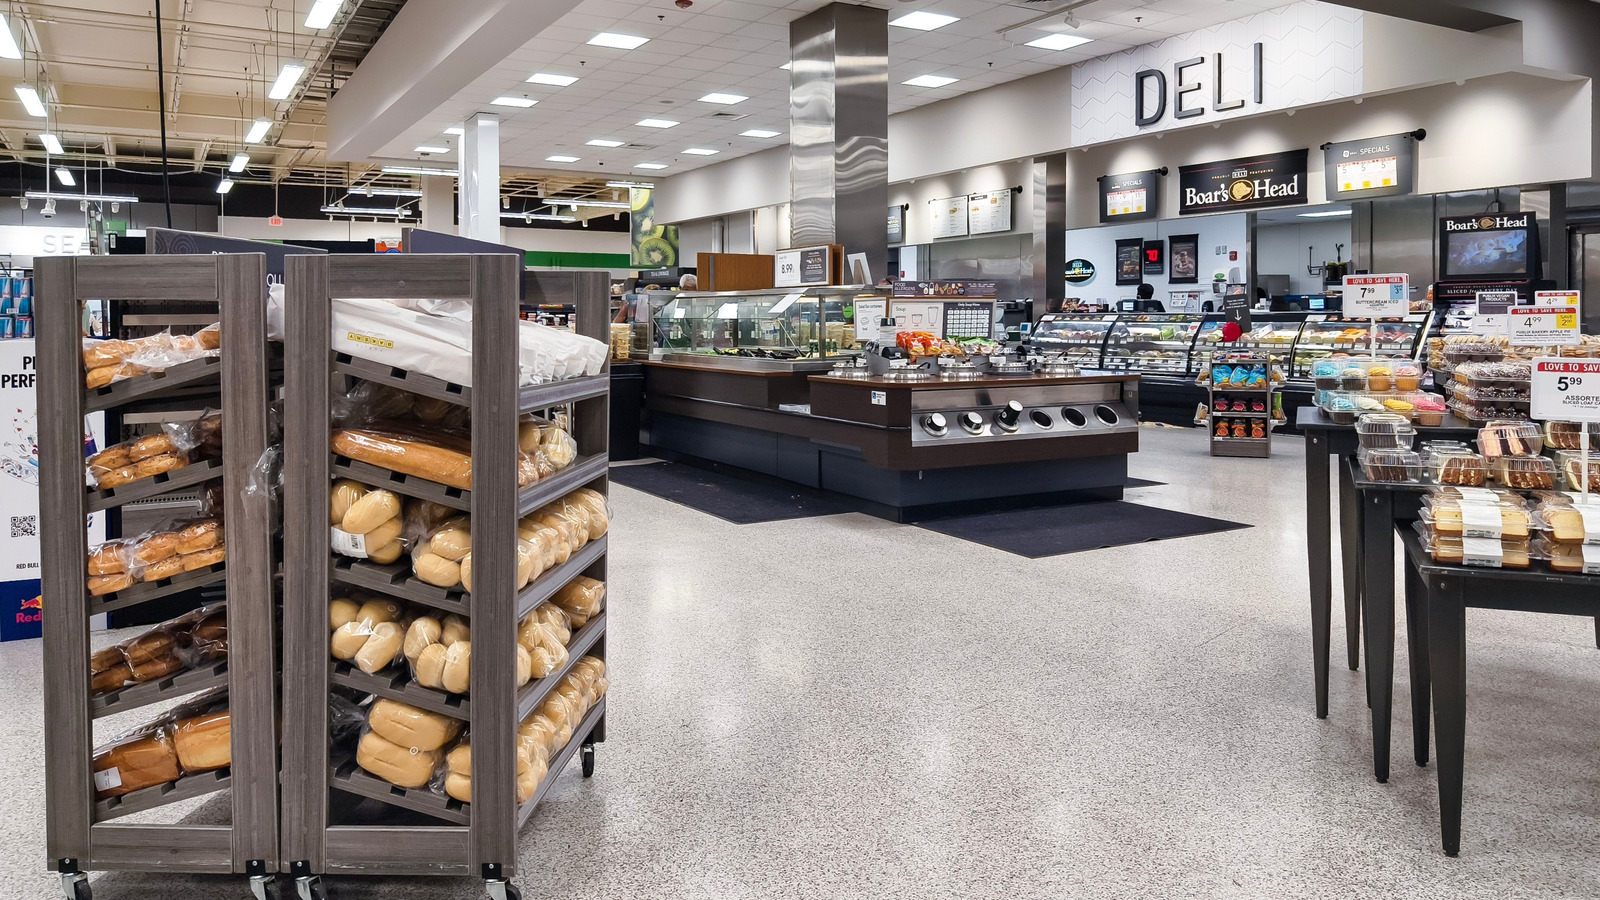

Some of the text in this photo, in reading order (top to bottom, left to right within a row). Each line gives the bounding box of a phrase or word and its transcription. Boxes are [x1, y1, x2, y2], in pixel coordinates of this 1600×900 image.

[1135, 42, 1263, 127] DELI
[1360, 145, 1390, 156] SPECIALS
[1122, 179, 1142, 188] SPECIALS
[1185, 174, 1299, 206] Boar's Head
[1446, 215, 1528, 231] Boar's Head
[781, 263, 793, 274] 8.99
[1544, 362, 1564, 371] LOVE
[1568, 363, 1579, 371] TO
[16, 610, 42, 624] Red
